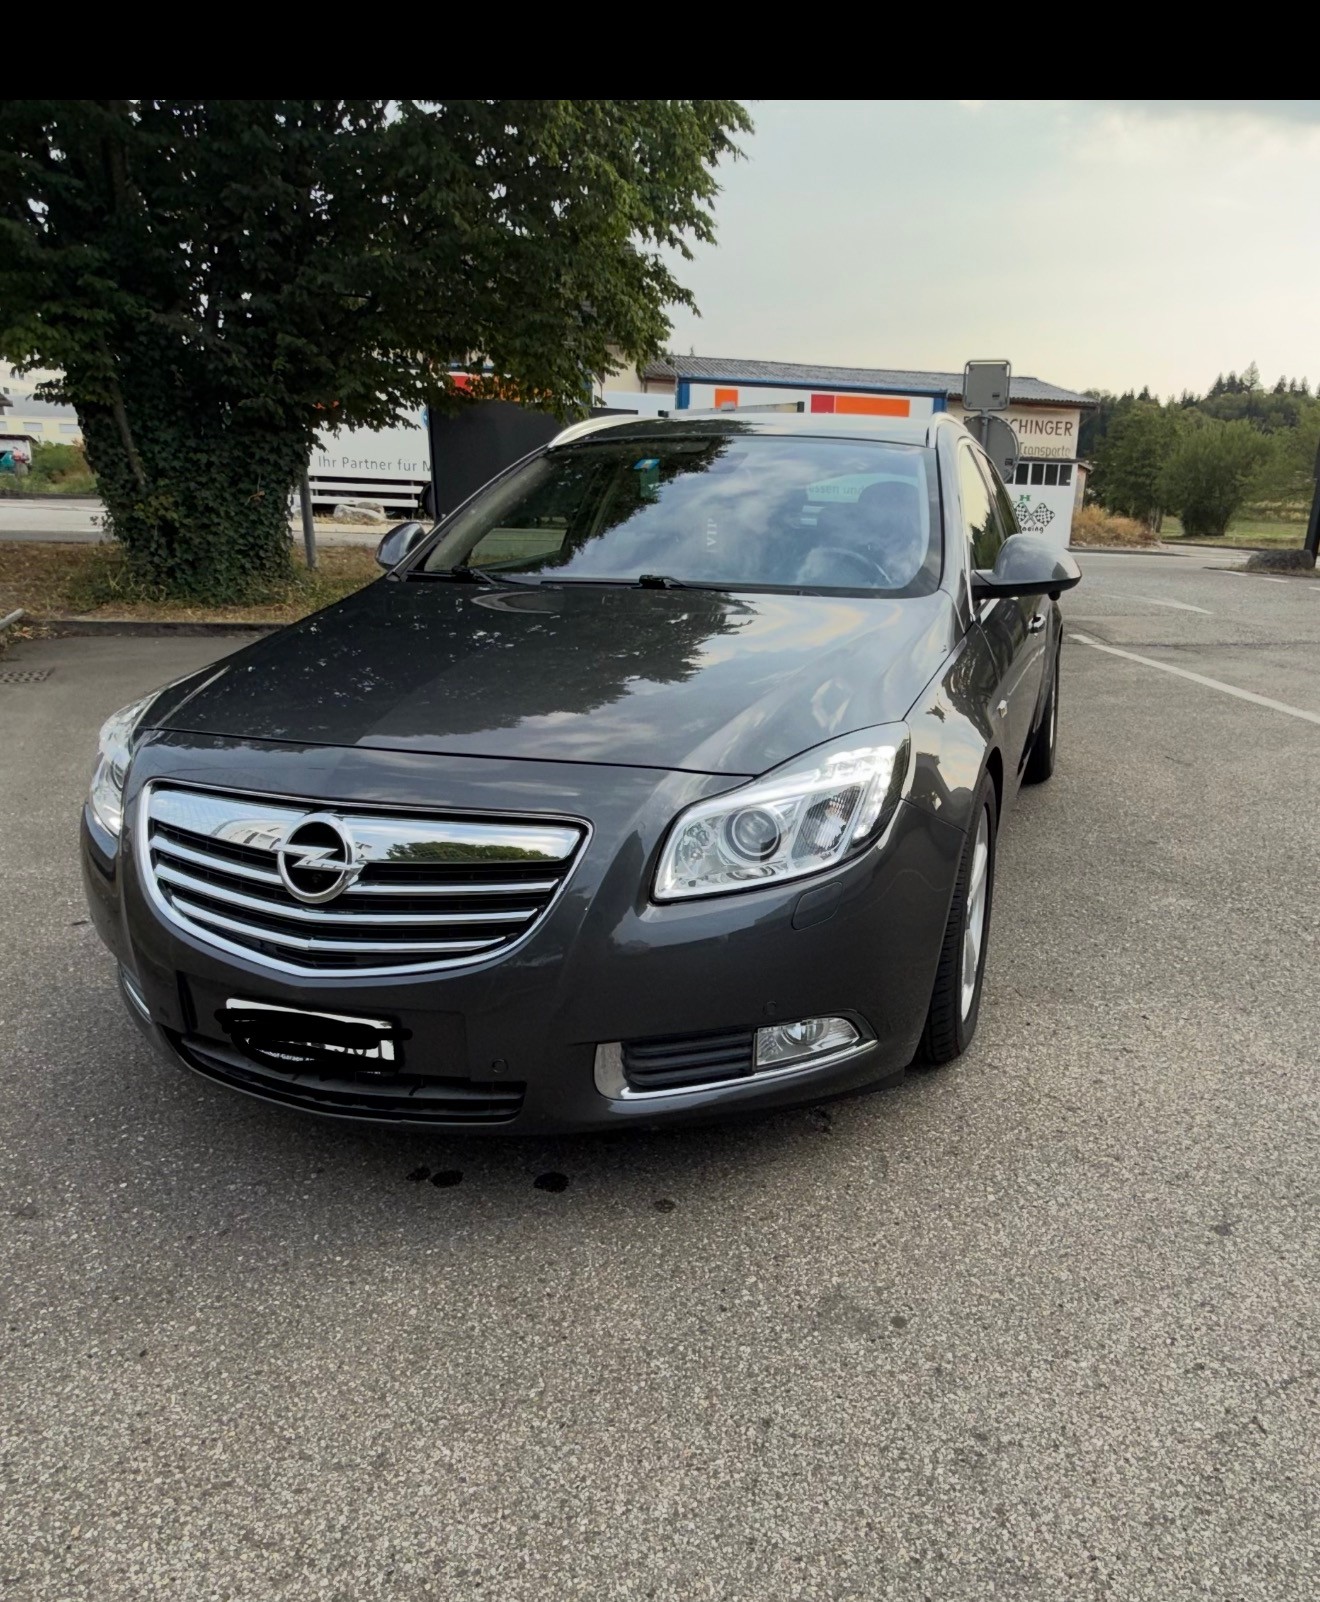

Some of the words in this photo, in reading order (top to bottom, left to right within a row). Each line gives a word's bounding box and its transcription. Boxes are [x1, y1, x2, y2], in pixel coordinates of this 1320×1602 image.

[1004, 417, 1074, 437] CHINGER
[318, 455, 337, 468] Ihr
[342, 456, 392, 471] Partner
